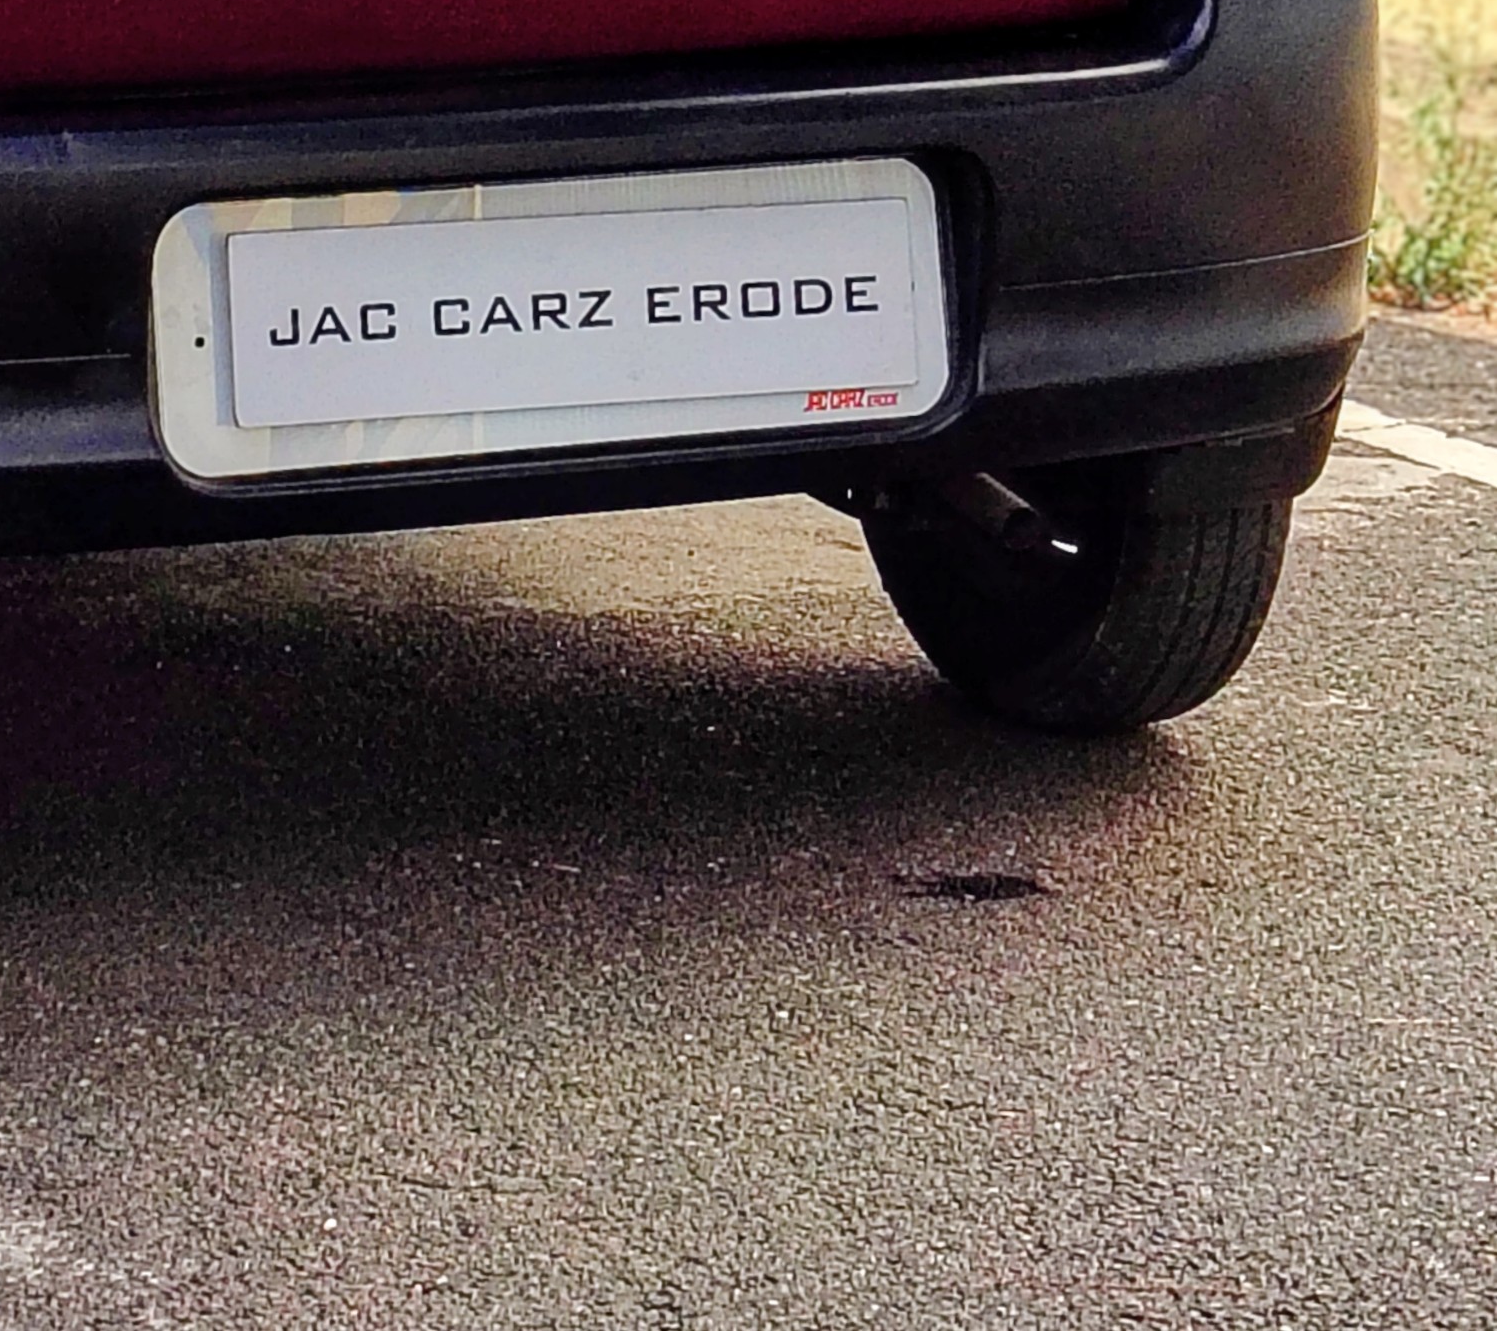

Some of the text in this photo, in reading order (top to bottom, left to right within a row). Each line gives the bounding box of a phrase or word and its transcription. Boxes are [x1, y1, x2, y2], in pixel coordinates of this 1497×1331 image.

[269, 275, 879, 348] JAC CARZ ERODE
[829, 388, 865, 410] CARZ
